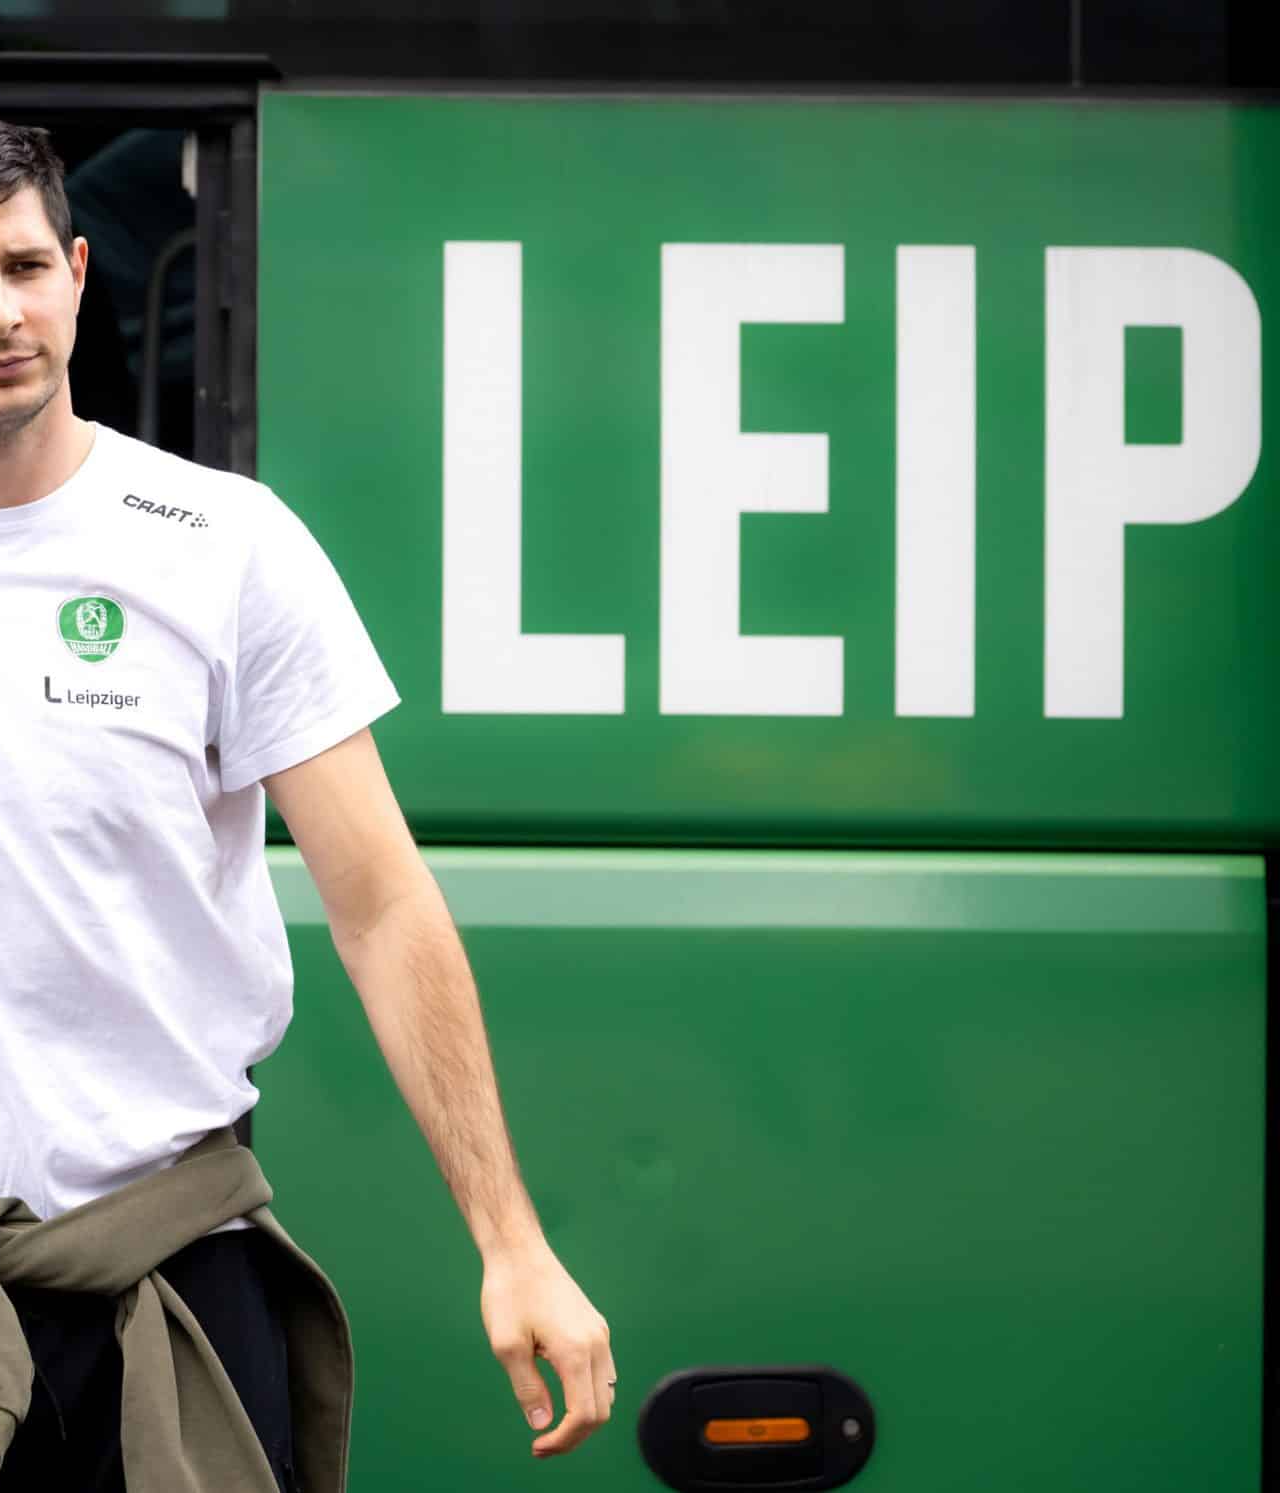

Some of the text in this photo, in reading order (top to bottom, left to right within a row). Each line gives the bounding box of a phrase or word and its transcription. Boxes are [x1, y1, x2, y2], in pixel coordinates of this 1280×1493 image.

[441, 240, 1262, 718] LEIP
[122, 494, 193, 523] CRAFT
[67, 689, 141, 710] Leipziger
